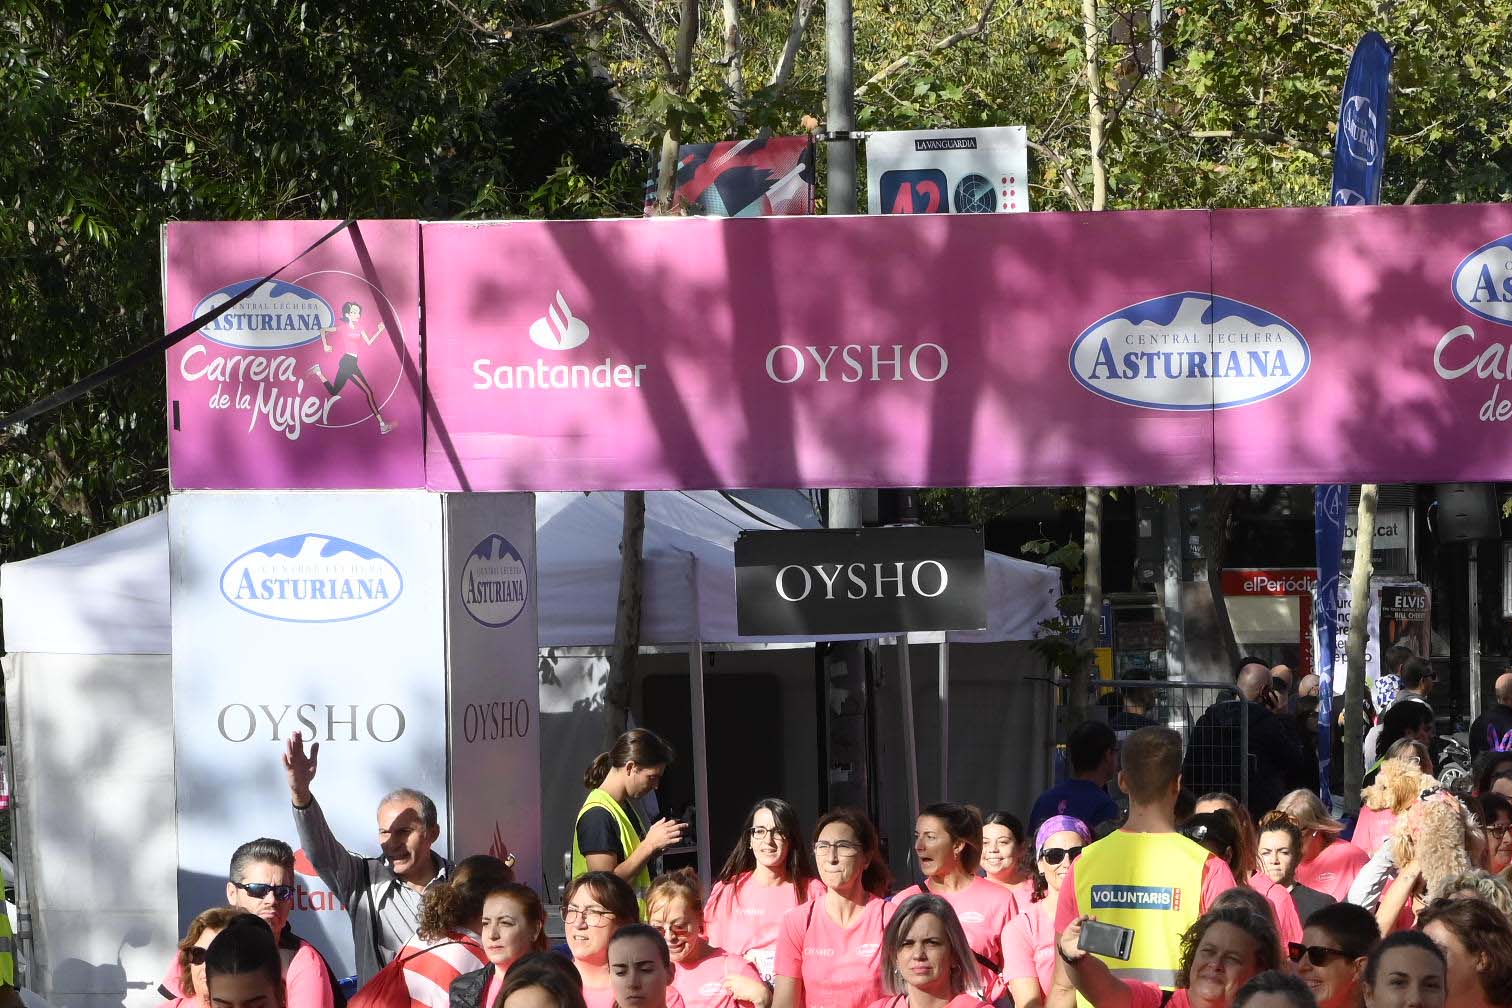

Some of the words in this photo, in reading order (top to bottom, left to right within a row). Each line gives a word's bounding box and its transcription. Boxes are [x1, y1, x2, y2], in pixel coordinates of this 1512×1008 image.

[204, 304, 323, 331] ASTURIANA
[234, 303, 269, 311] ENTRAL
[1125, 333, 1200, 345] CENTRAL
[1207, 332, 1284, 344] LECHERA
[180, 345, 297, 382] Carrera
[472, 357, 646, 390] Santander
[765, 343, 949, 383] OYSHO
[1088, 337, 1291, 380] ASTURIANA
[208, 384, 231, 410] de
[235, 383, 251, 410] la
[248, 379, 341, 441] Mujer
[1479, 383, 1512, 422] de
[234, 567, 390, 600] ASTURIANA
[466, 569, 524, 604] ASTURIANA
[775, 560, 949, 602] OYSHO
[1394, 595, 1425, 608] ELVIS
[217, 703, 406, 744] OYSHO
[463, 699, 529, 744] OYSHO
